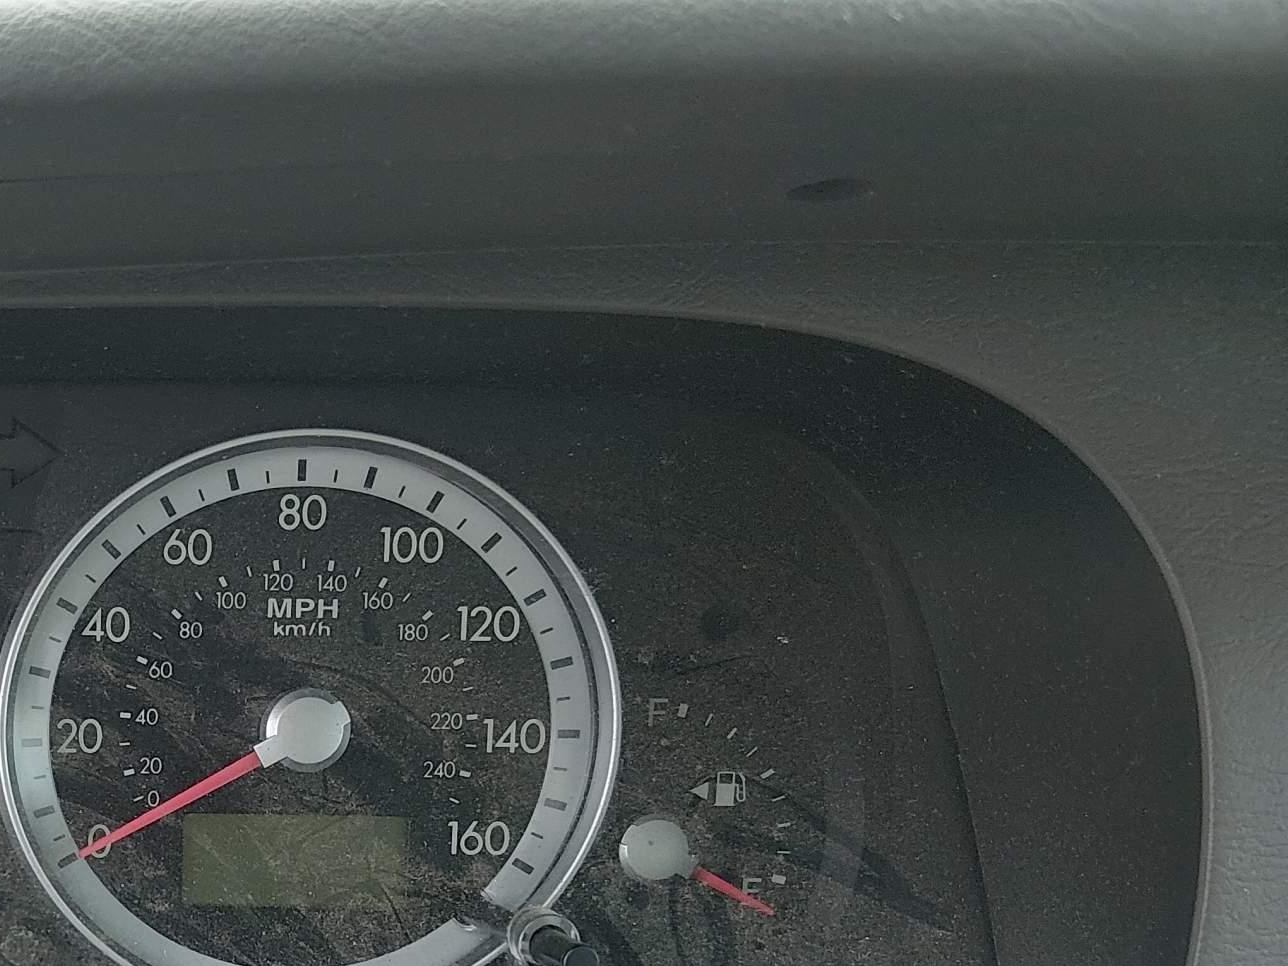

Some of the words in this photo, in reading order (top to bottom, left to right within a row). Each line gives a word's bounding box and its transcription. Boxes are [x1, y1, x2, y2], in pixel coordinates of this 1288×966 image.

[277, 493, 327, 531] 80
[163, 529, 212, 566] 60
[380, 527, 443, 564] 100
[263, 574, 294, 591] 120
[316, 575, 348, 592] 140
[215, 592, 246, 610] 100
[267, 598, 339, 619] MPH
[363, 592, 393, 610] 160
[81, 606, 130, 643] 40
[179, 621, 203, 639] 80
[273, 621, 332, 637] km/h
[398, 623, 429, 642] 180
[457, 606, 520, 643] 120
[148, 661, 173, 679] 60
[421, 666, 454, 684] 200
[135, 708, 159, 726] 40
[648, 698, 668, 726] F
[430, 713, 463, 731] 220
[57, 719, 102, 754] 20
[483, 718, 545, 754] 140
[140, 757, 162, 775] 20
[423, 761, 455, 778] 240
[147, 790, 160, 807] 0
[87, 825, 112, 858] 0
[448, 821, 510, 856] 160
